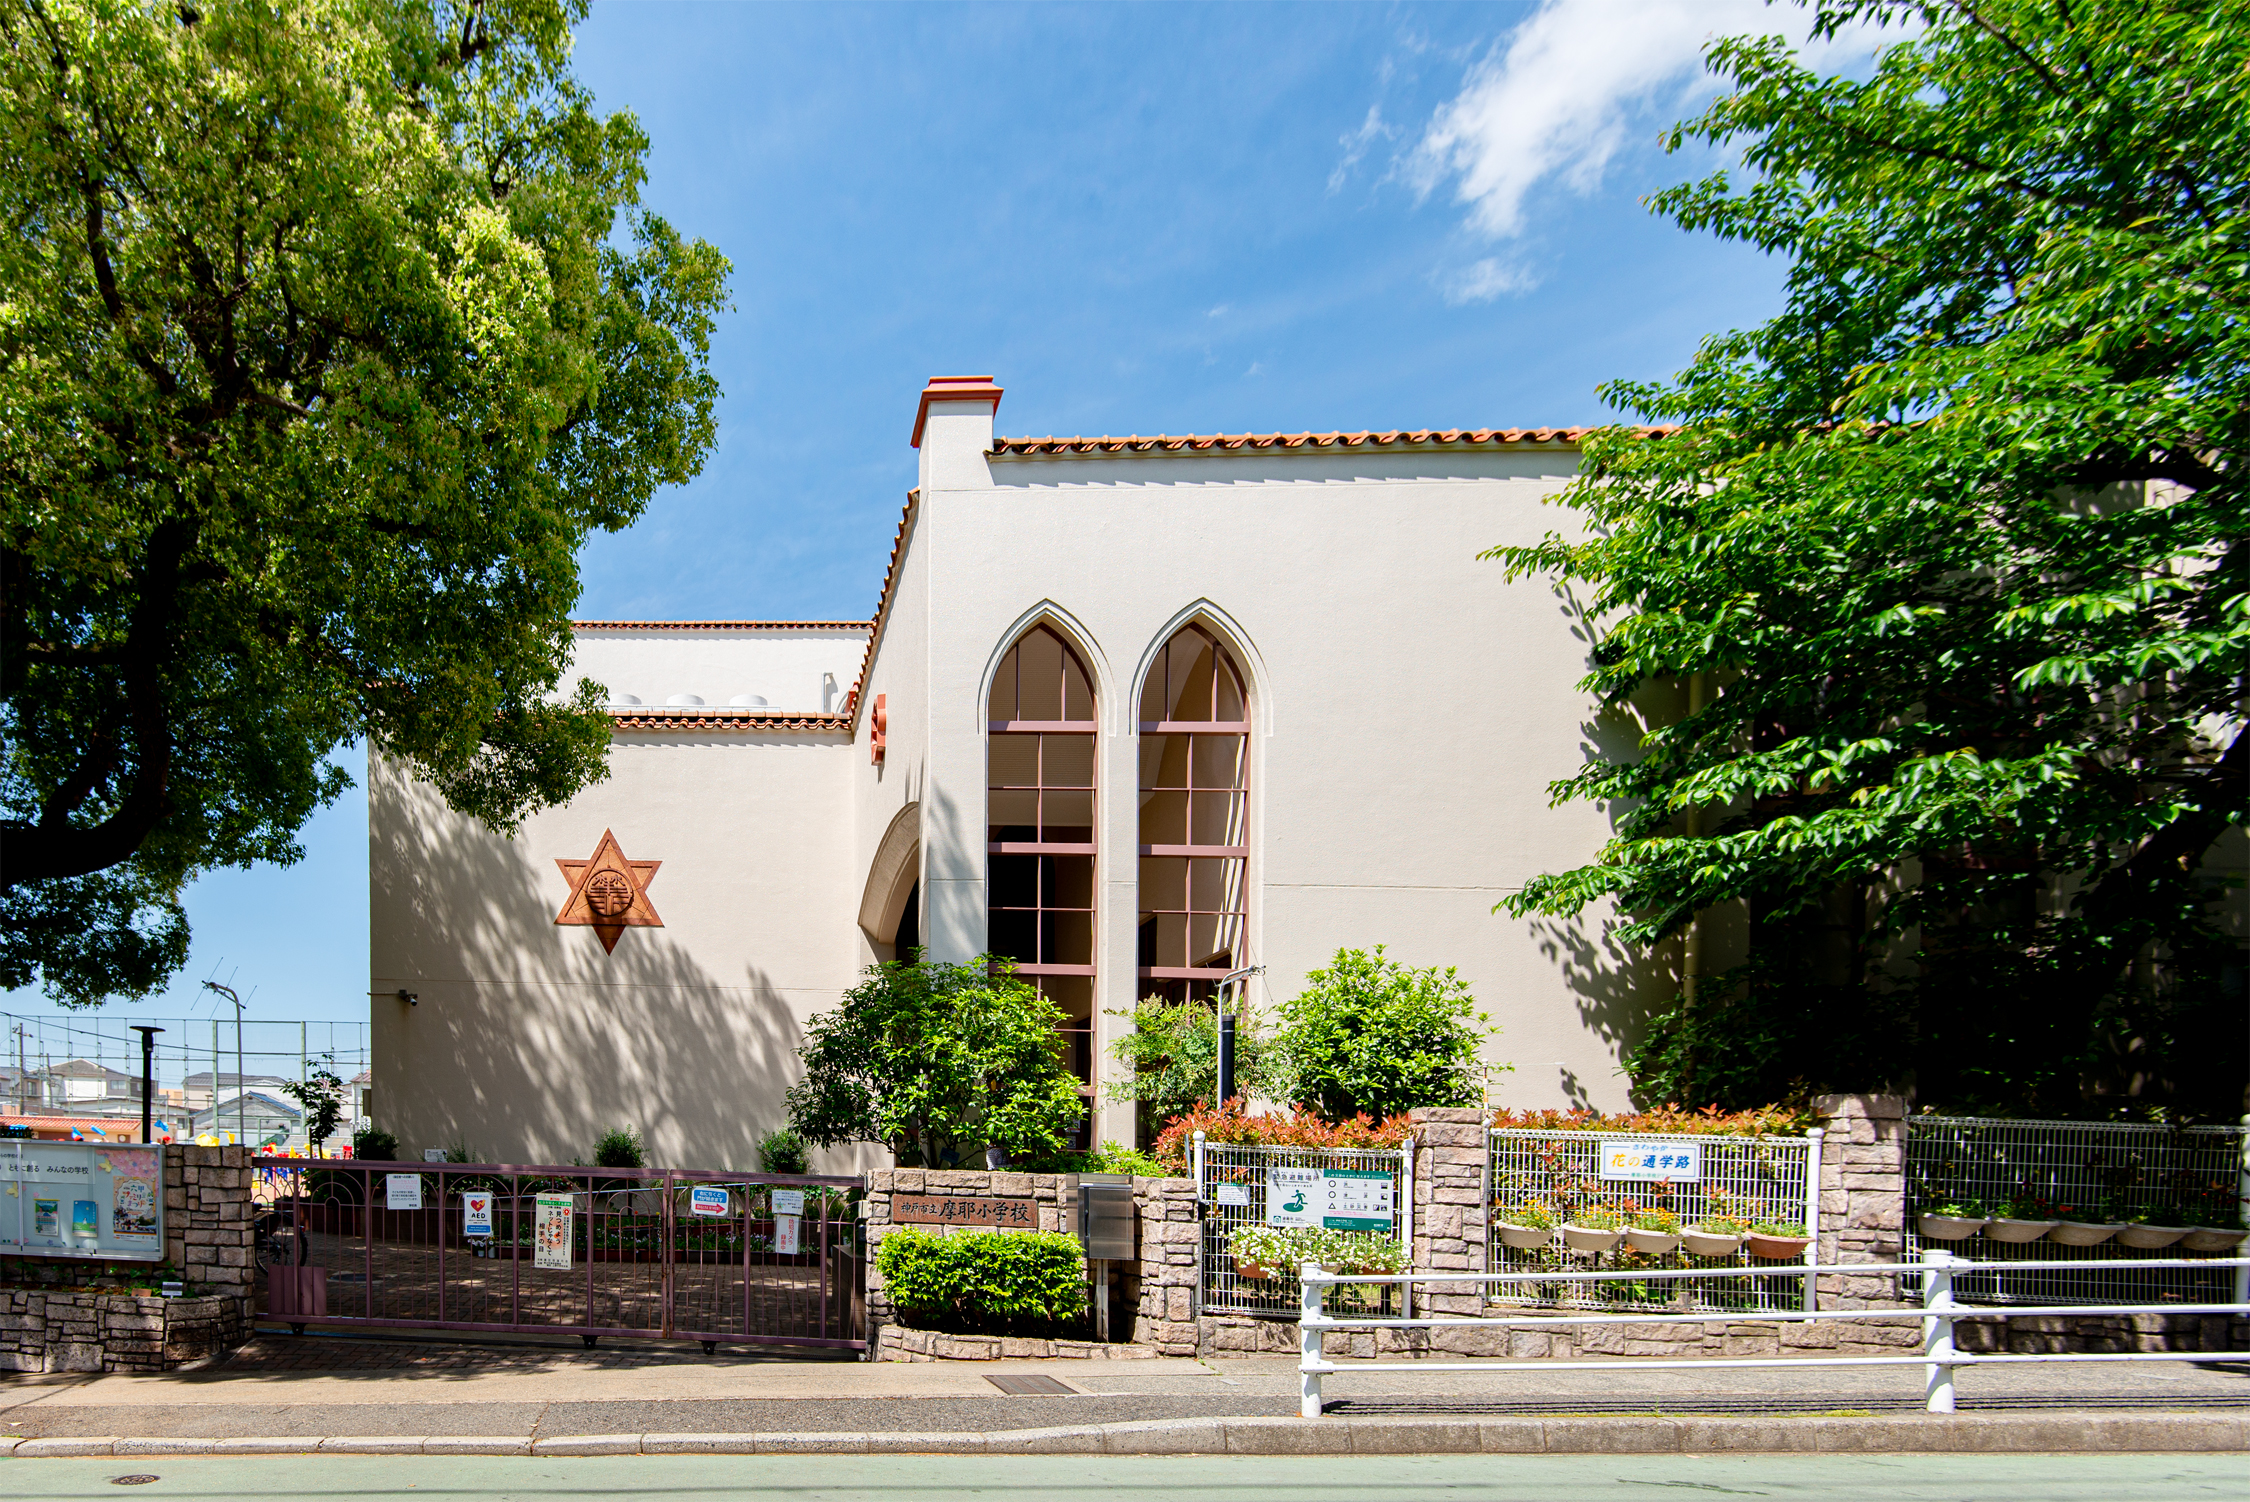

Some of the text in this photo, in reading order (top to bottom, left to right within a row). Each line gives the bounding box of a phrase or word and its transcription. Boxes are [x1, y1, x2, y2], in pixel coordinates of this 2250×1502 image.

[1632, 1144, 1668, 1152] さわやか
[9, 1164, 39, 1172] ともに創る
[47, 1165, 89, 1174] みんなの学校
[1611, 1153, 1690, 1169] 花の通学路
[1272, 1173, 1319, 1182] 緊急避難場所
[901, 1200, 1030, 1222] 神戸市立摩耶小学校
[538, 1222, 546, 1253] 相手の目
[546, 1210, 554, 1257] ネットじゃなくて
